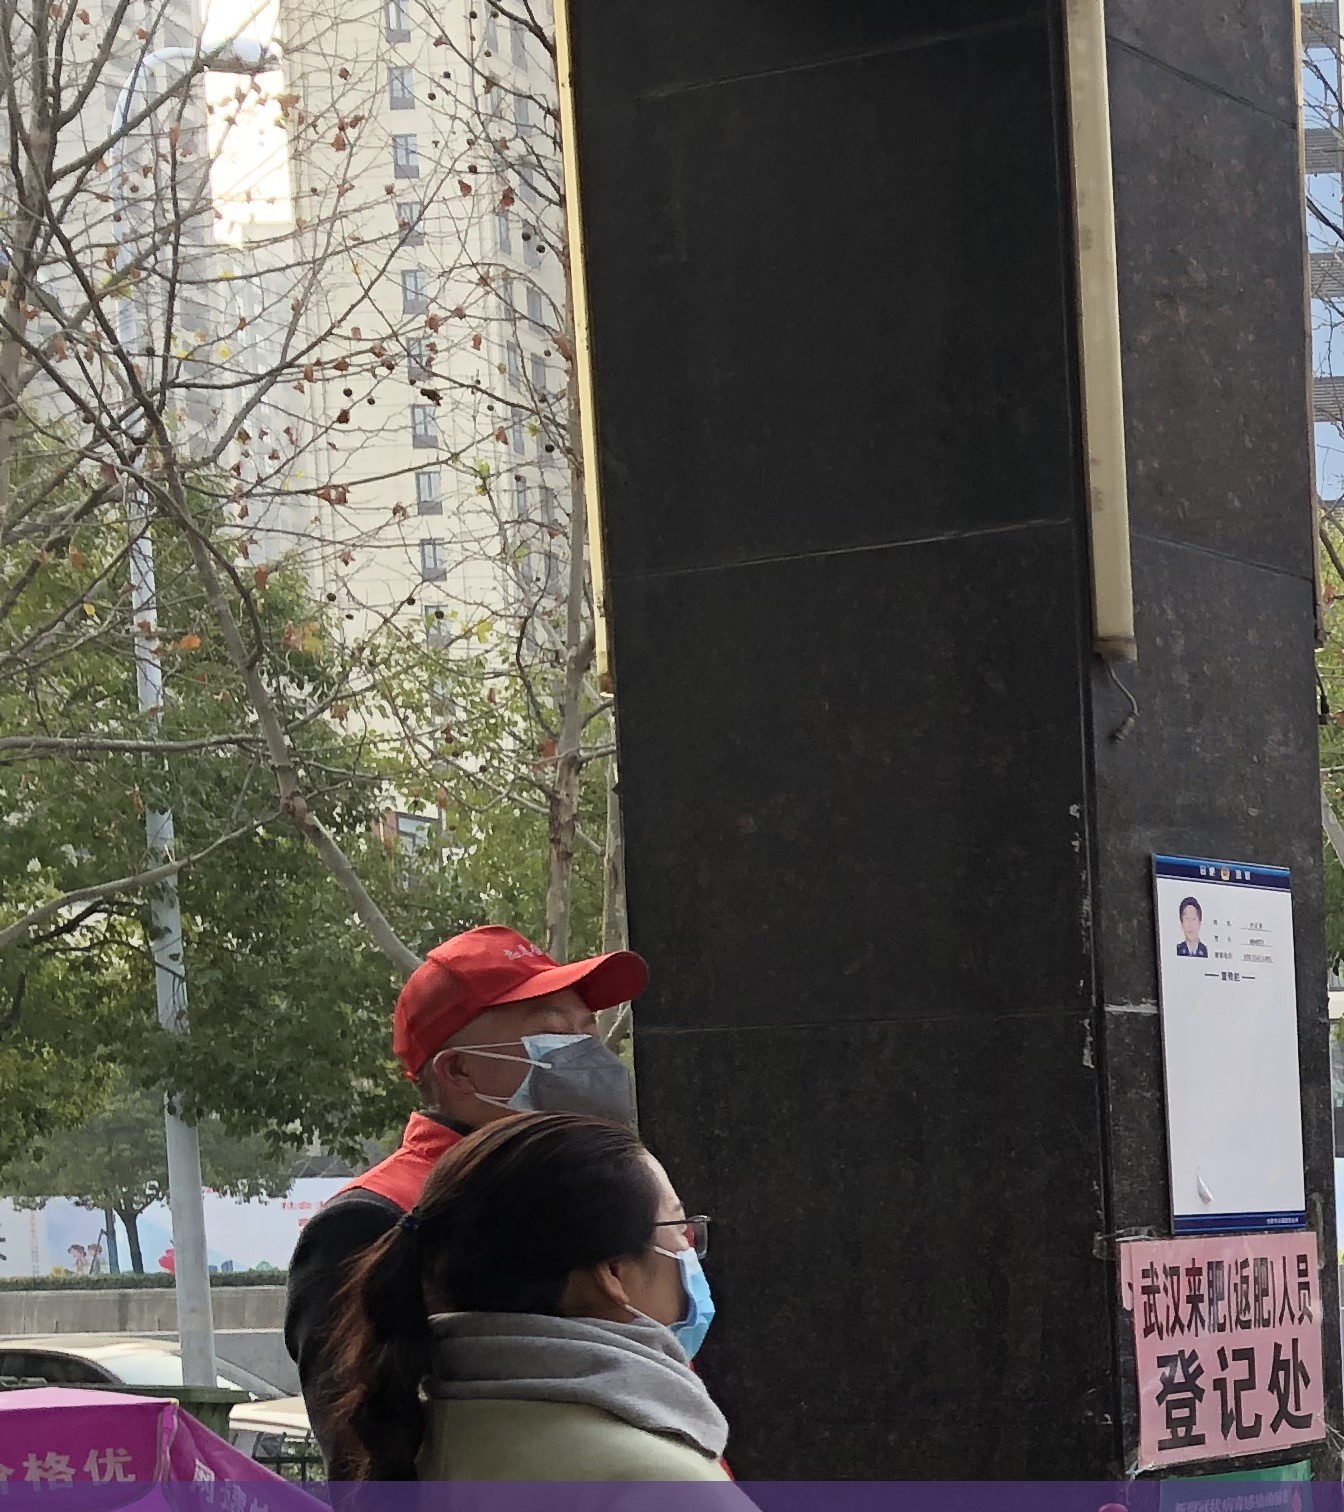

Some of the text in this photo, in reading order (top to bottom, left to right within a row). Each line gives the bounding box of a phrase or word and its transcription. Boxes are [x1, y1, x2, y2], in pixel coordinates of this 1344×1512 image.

[1140, 1253, 1314, 1341] 武汉来肥(返肥)人员
[1155, 1338, 1313, 1453] 登记处
